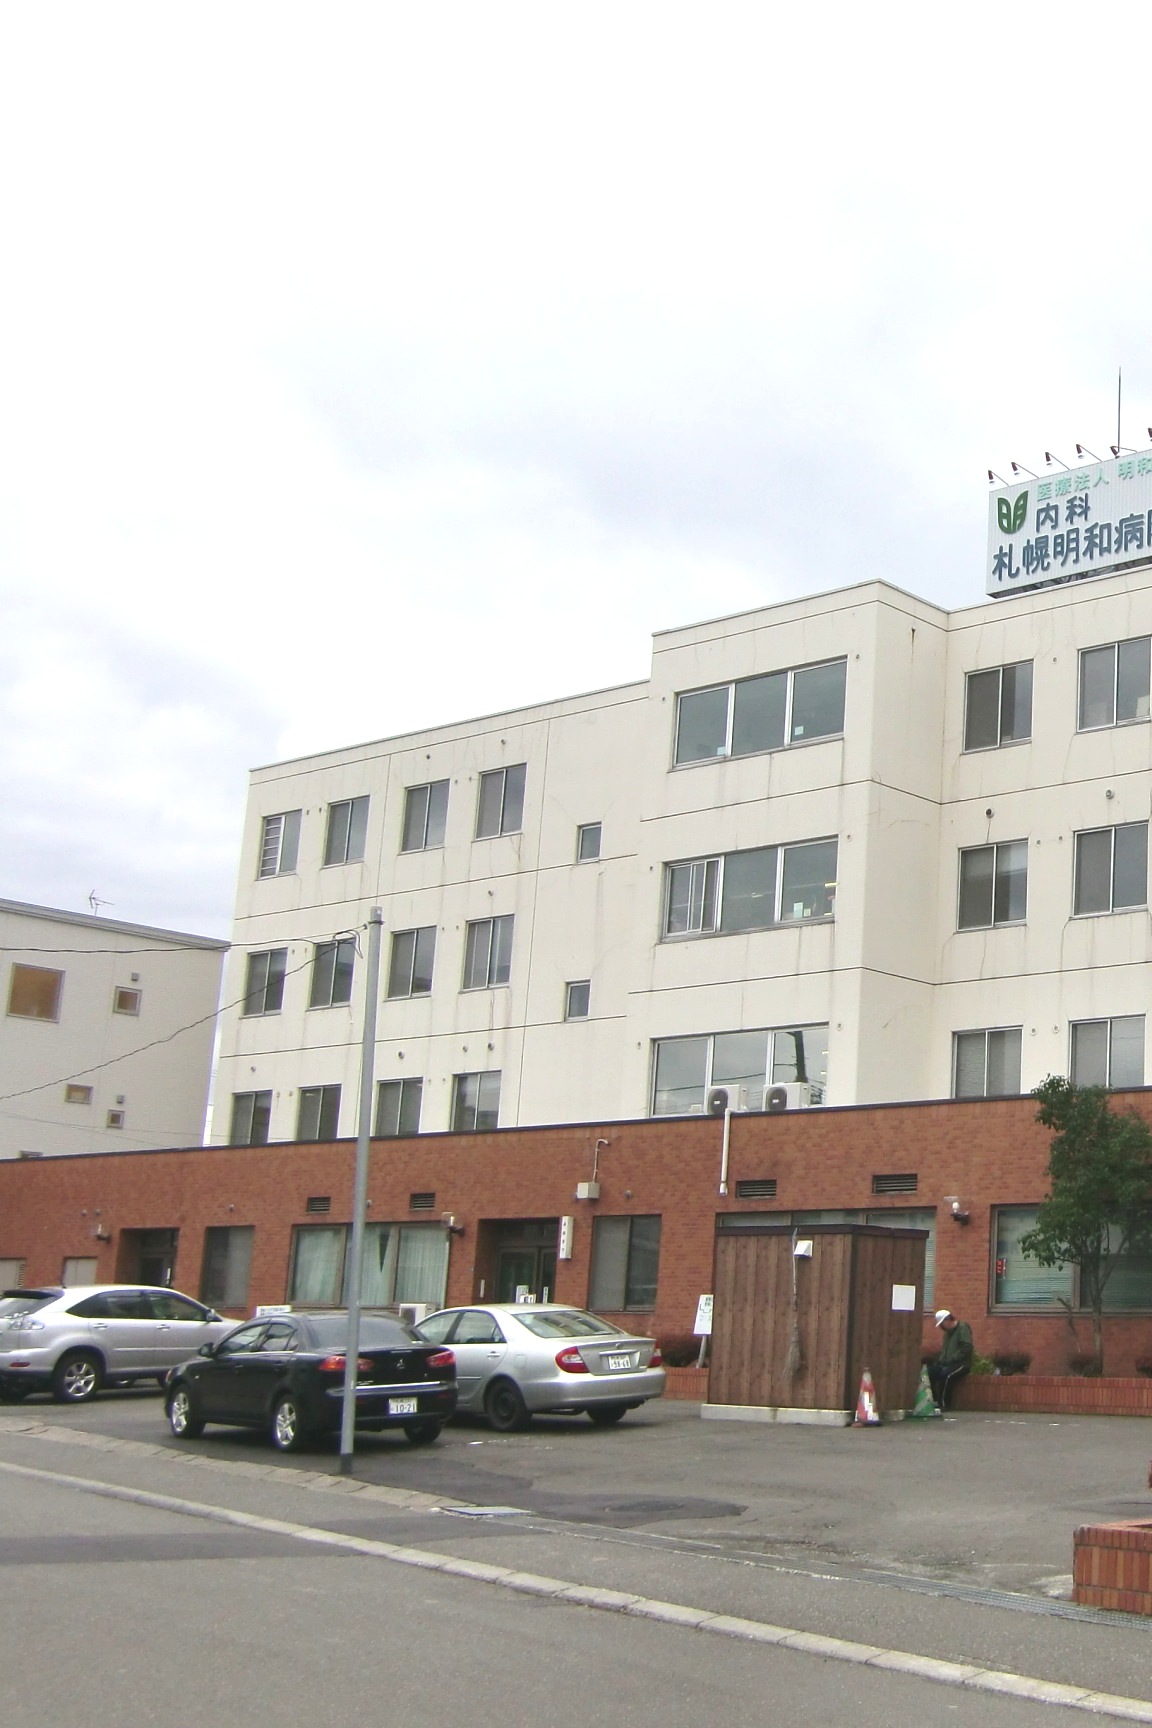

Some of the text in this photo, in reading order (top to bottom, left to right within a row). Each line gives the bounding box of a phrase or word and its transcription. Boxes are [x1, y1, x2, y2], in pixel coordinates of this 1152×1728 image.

[1036, 467, 1110, 502] 医療法人
[1036, 493, 1091, 533] 内科
[395, 1403, 416, 1413] 10-21
